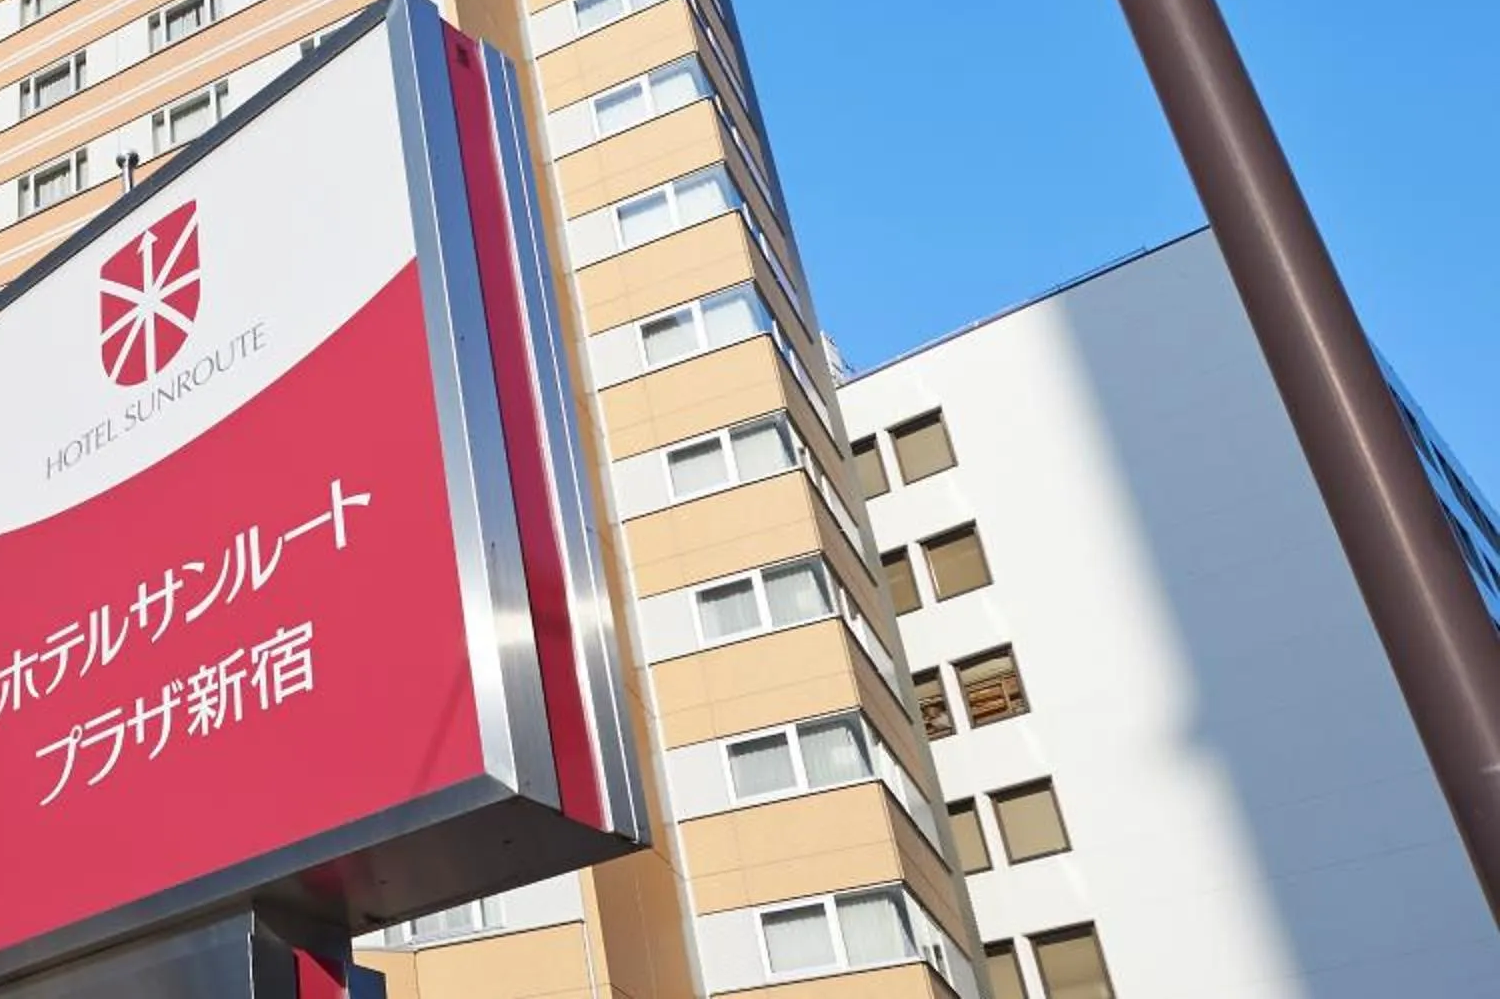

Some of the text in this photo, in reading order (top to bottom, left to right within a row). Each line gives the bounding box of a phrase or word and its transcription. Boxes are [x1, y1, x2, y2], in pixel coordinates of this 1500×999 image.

[47, 323, 268, 479] HOTEL SUNROUTE
[36, 622, 314, 805] プラザ新宿
